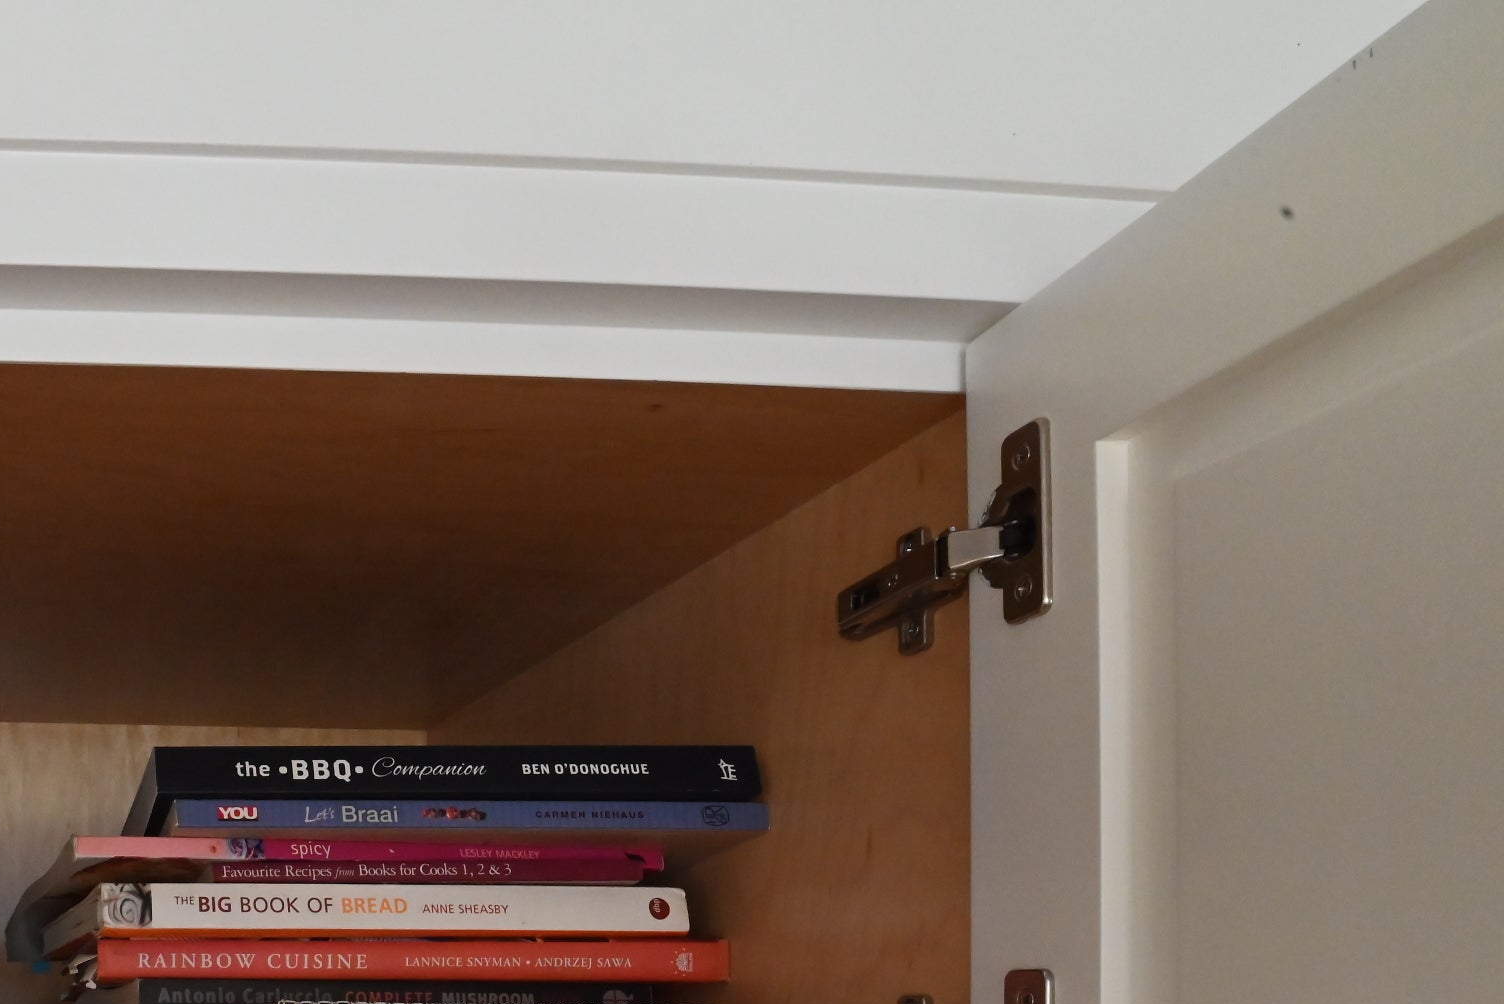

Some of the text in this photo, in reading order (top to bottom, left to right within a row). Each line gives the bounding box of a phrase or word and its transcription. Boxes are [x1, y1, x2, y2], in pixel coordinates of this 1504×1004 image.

[235, 761, 270, 777] the
[371, 756, 487, 781] Companion
[521, 763, 650, 775] BEN O'DONOGHUE
[217, 805, 399, 823] YOU Let's Braai
[535, 811, 645, 819] CARMEN NIEHAUS
[290, 841, 331, 859] spicy
[459, 849, 540, 860] LESLEY MACKLEY
[222, 863, 512, 880] Favourite Recipes from Books for Cooks 1, 2 & 3
[174, 896, 408, 914] THE BIG BOOK OF BREAD
[422, 904, 509, 914] ANNE SHEASBY
[138, 953, 368, 969] RAINBOW CUISINE
[405, 957, 522, 967] LANNICE SNYMAN
[535, 957, 632, 970] ANDRZEJ SAWA
[158, 987, 236, 1004] Antonio
